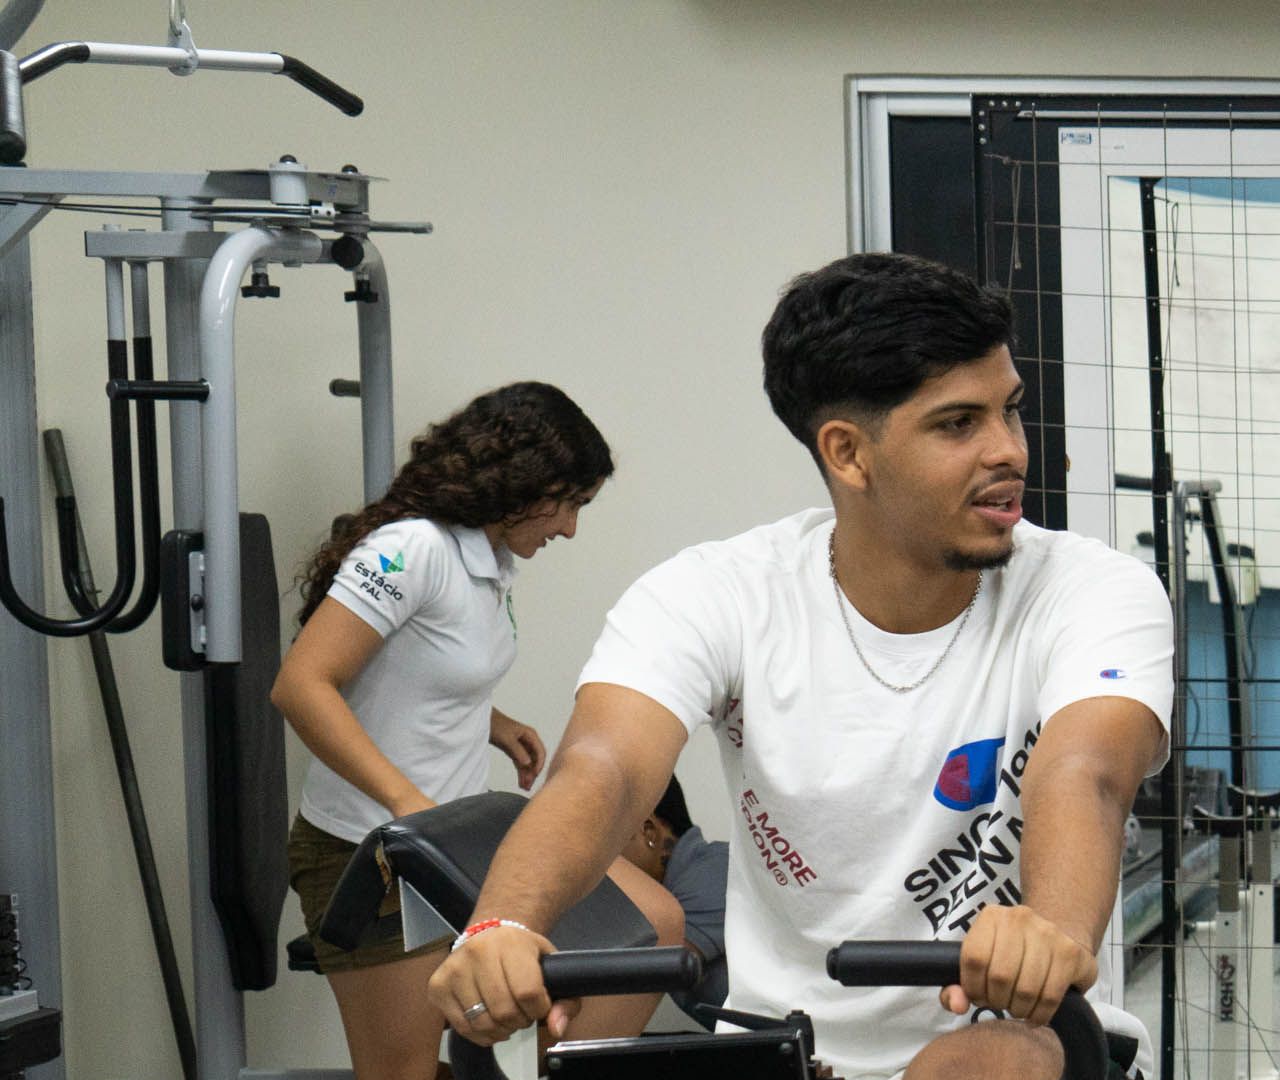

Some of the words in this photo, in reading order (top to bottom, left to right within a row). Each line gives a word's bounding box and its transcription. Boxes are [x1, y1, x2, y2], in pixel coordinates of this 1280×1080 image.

[354, 561, 403, 601] Estácio
[360, 581, 381, 601] FAL
[741, 799, 789, 887] PION®
[756, 811, 817, 888] MORE
